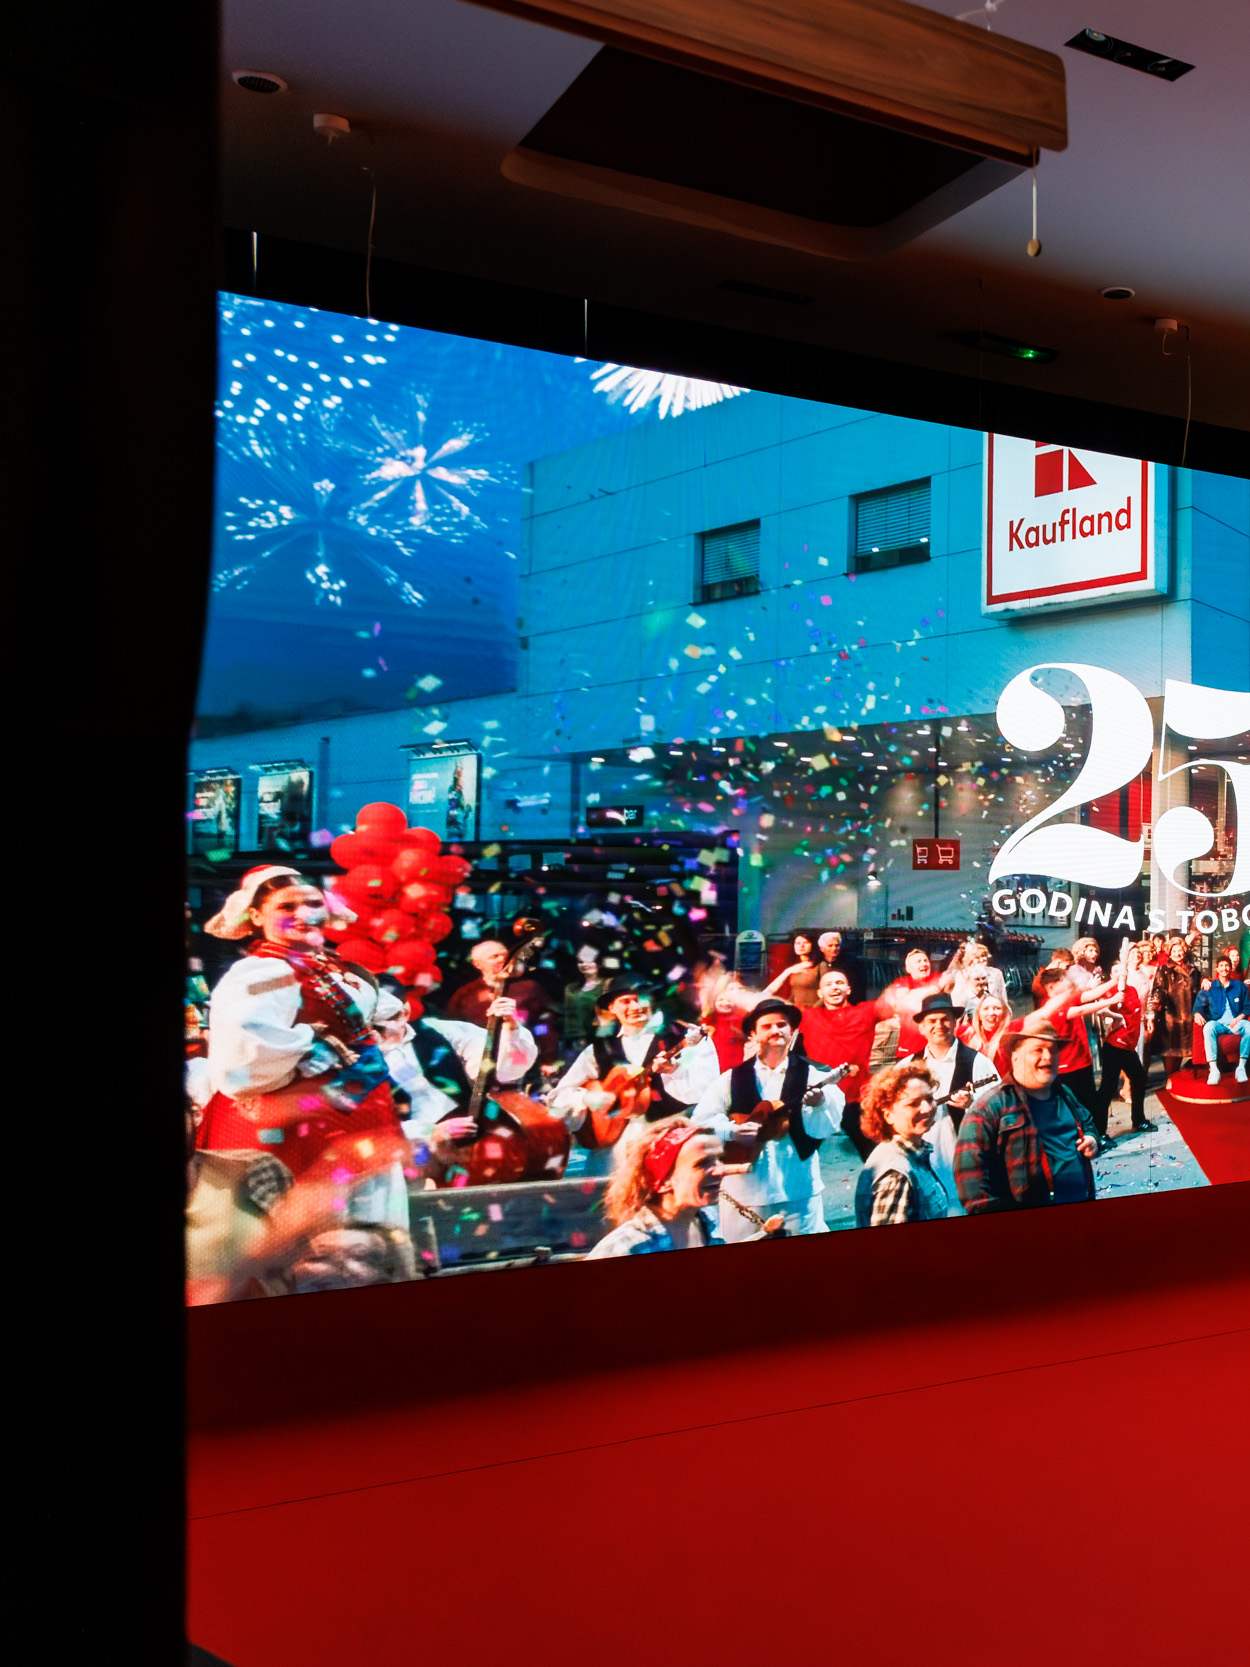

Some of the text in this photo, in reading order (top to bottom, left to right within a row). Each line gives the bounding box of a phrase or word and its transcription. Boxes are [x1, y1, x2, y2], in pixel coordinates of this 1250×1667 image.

[1008, 496, 1132, 552] Kaufland
[992, 889, 1137, 931] GODINA
[1147, 908, 1167, 934] S
